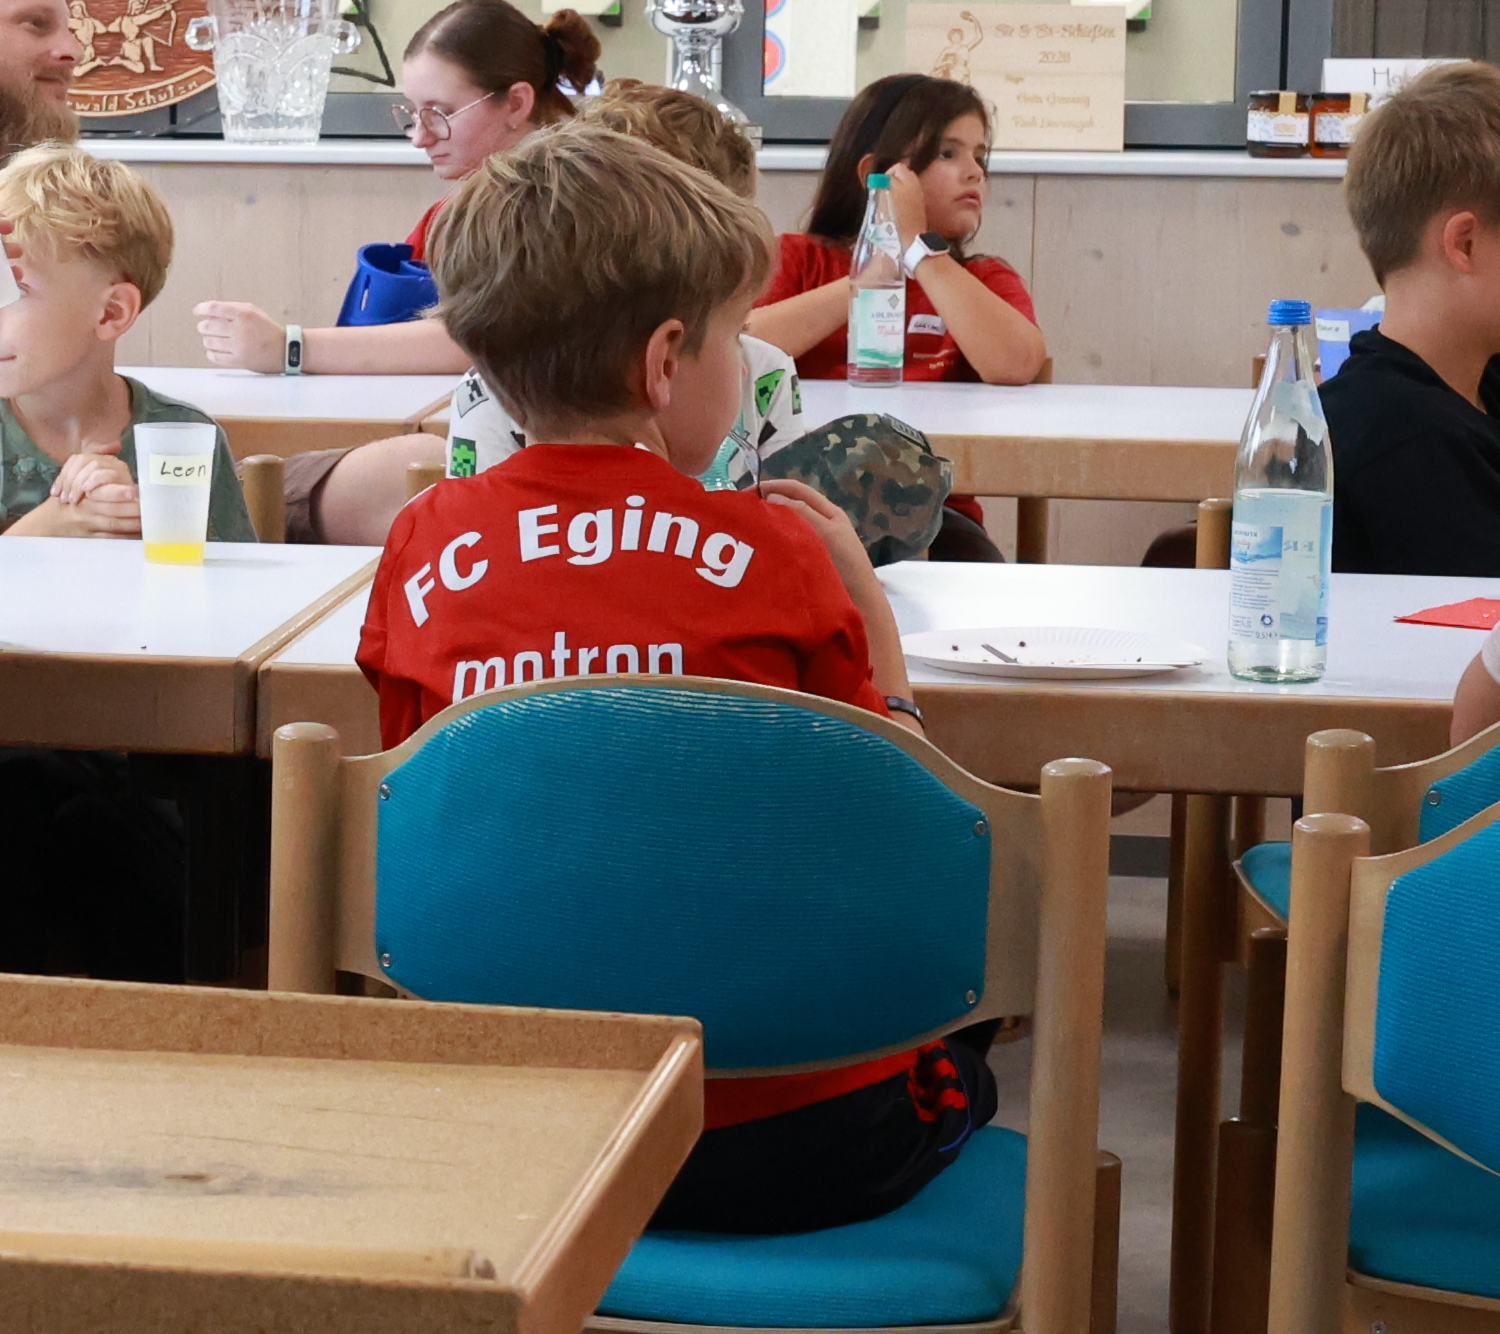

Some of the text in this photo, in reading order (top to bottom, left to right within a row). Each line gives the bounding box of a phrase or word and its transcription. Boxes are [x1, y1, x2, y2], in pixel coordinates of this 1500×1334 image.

[160, 459, 207, 480] Leon
[403, 494, 756, 629] FC Eging
